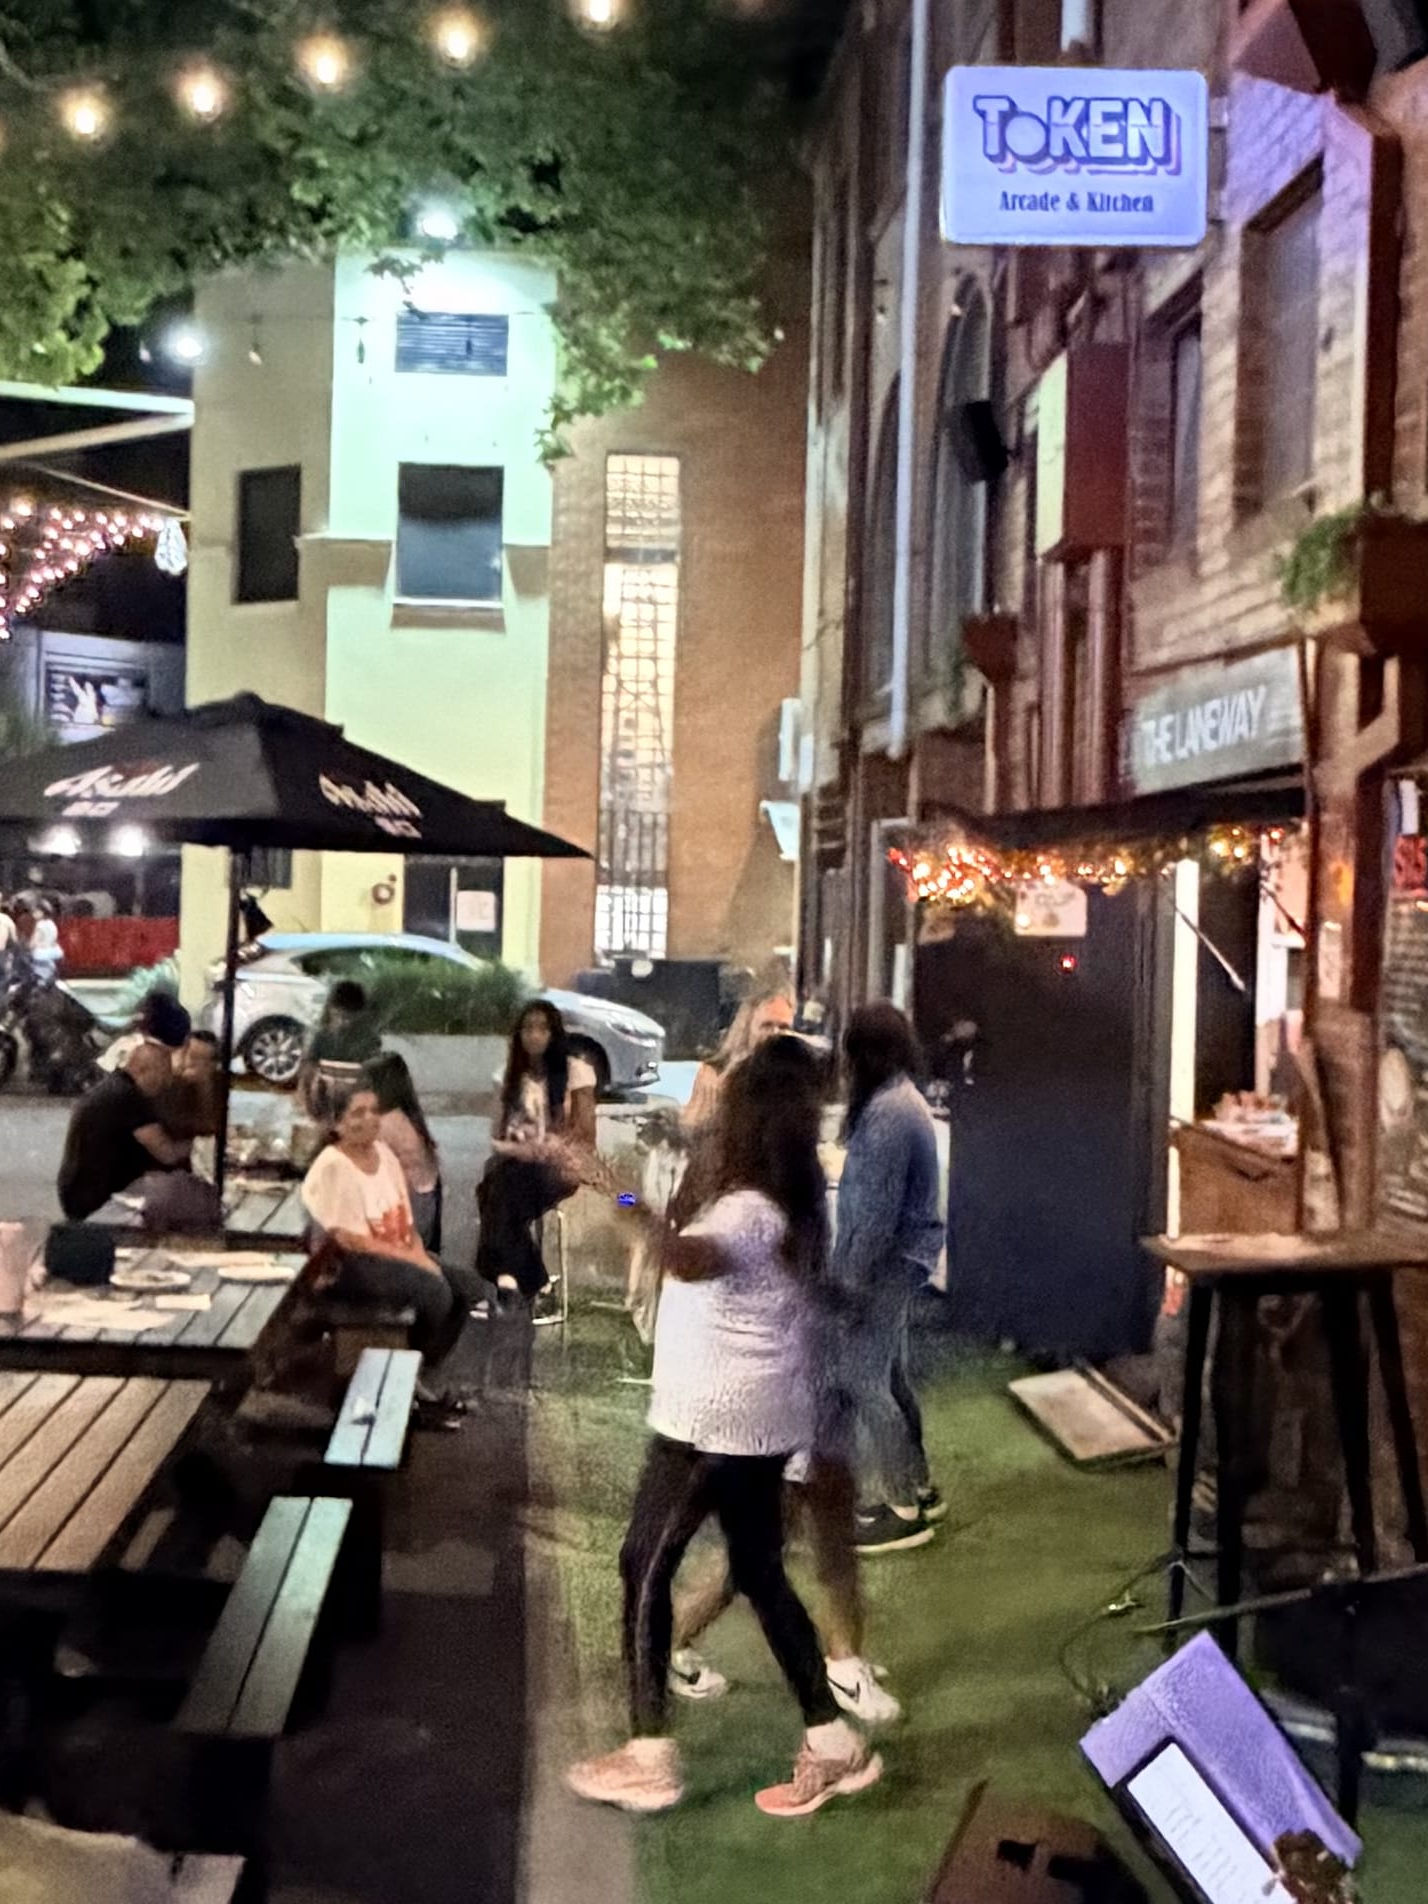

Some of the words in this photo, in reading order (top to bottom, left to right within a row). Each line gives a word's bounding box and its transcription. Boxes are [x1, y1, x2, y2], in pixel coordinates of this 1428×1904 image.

[1000, 190, 1060, 211] Arcade
[1066, 192, 1080, 211] &
[1141, 714, 1176, 766] THE
[1174, 684, 1266, 760] LANEWAY
